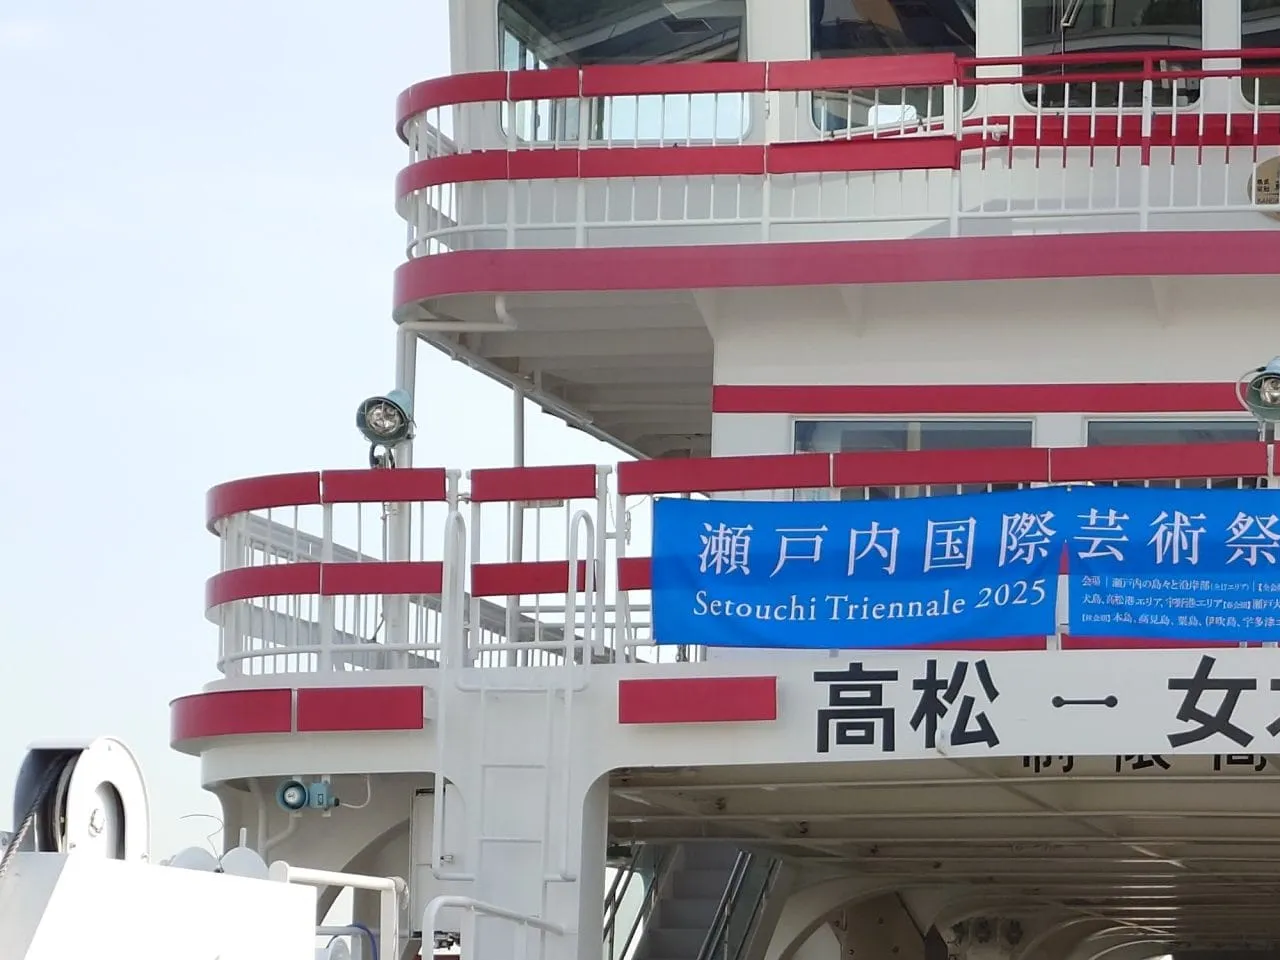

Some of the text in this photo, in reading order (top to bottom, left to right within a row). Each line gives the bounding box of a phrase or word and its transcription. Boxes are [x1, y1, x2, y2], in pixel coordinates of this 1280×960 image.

[694, 580, 1047, 622] Setouchi Triennale 2025
[813, 658, 1001, 754] 高松
